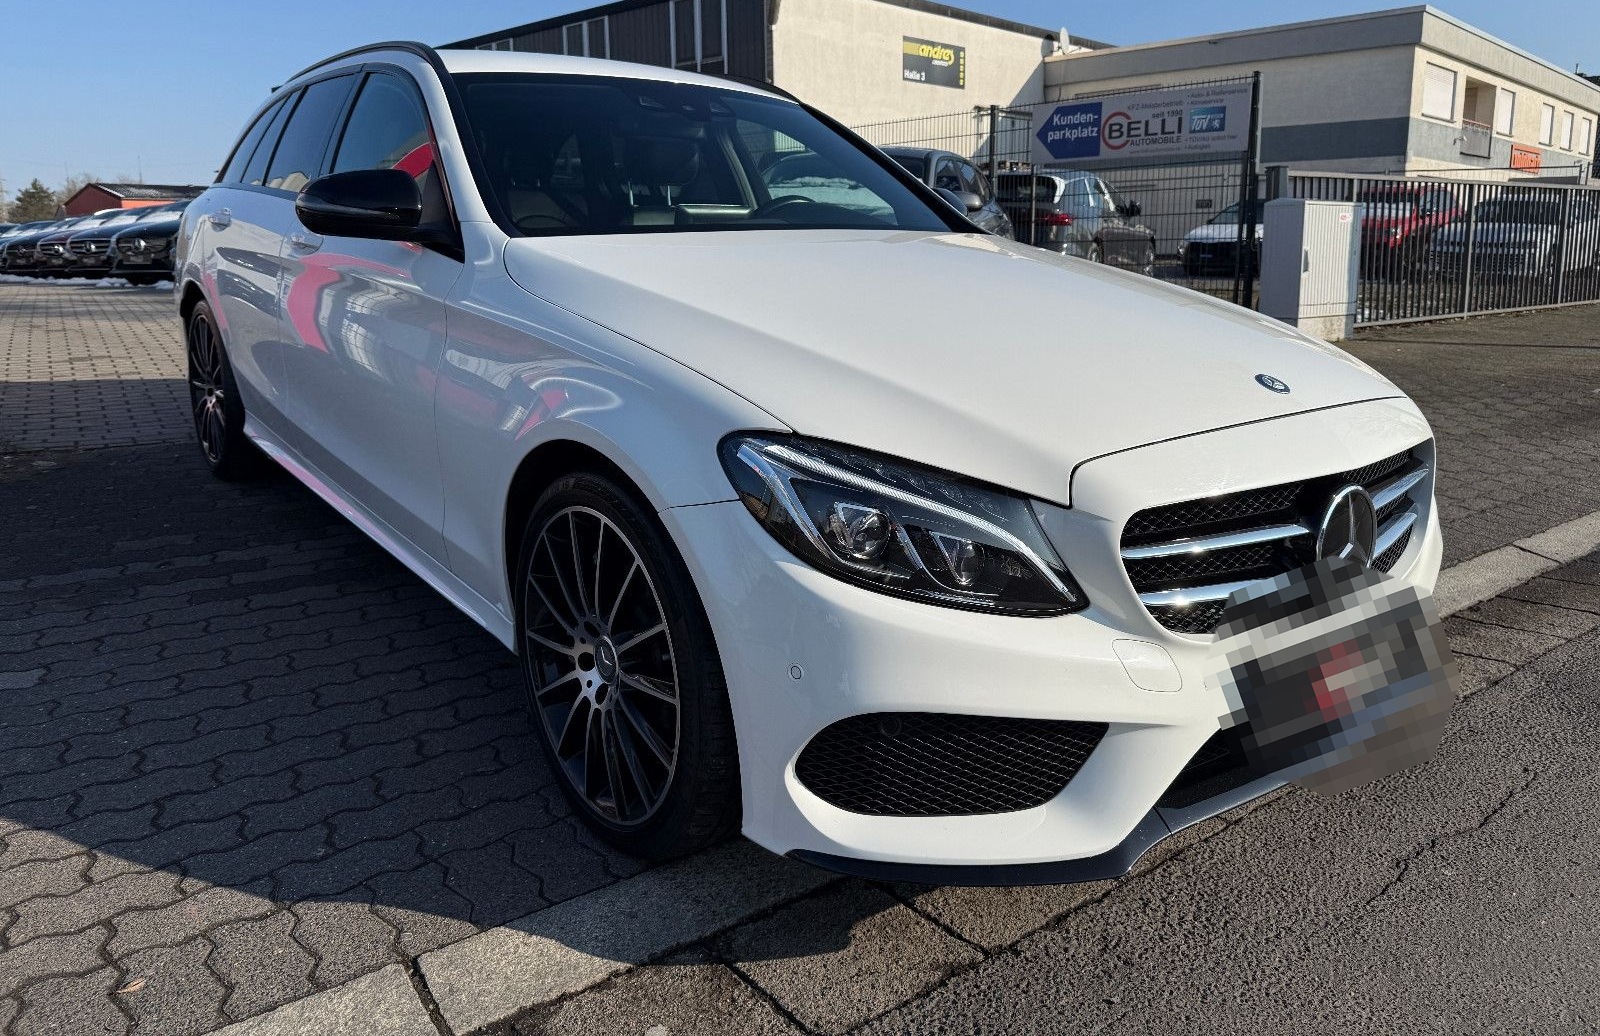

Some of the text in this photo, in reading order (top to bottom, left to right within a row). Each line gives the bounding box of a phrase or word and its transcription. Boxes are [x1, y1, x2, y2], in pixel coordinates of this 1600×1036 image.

[904, 69, 926, 81] Halle 3
[1053, 112, 1099, 125] Kunden-
[1152, 111, 1164, 119] seit
[1047, 126, 1098, 142] parkplatz
[1108, 117, 1183, 139] BELLI
[1130, 136, 1182, 146] AUTOMOBILE
